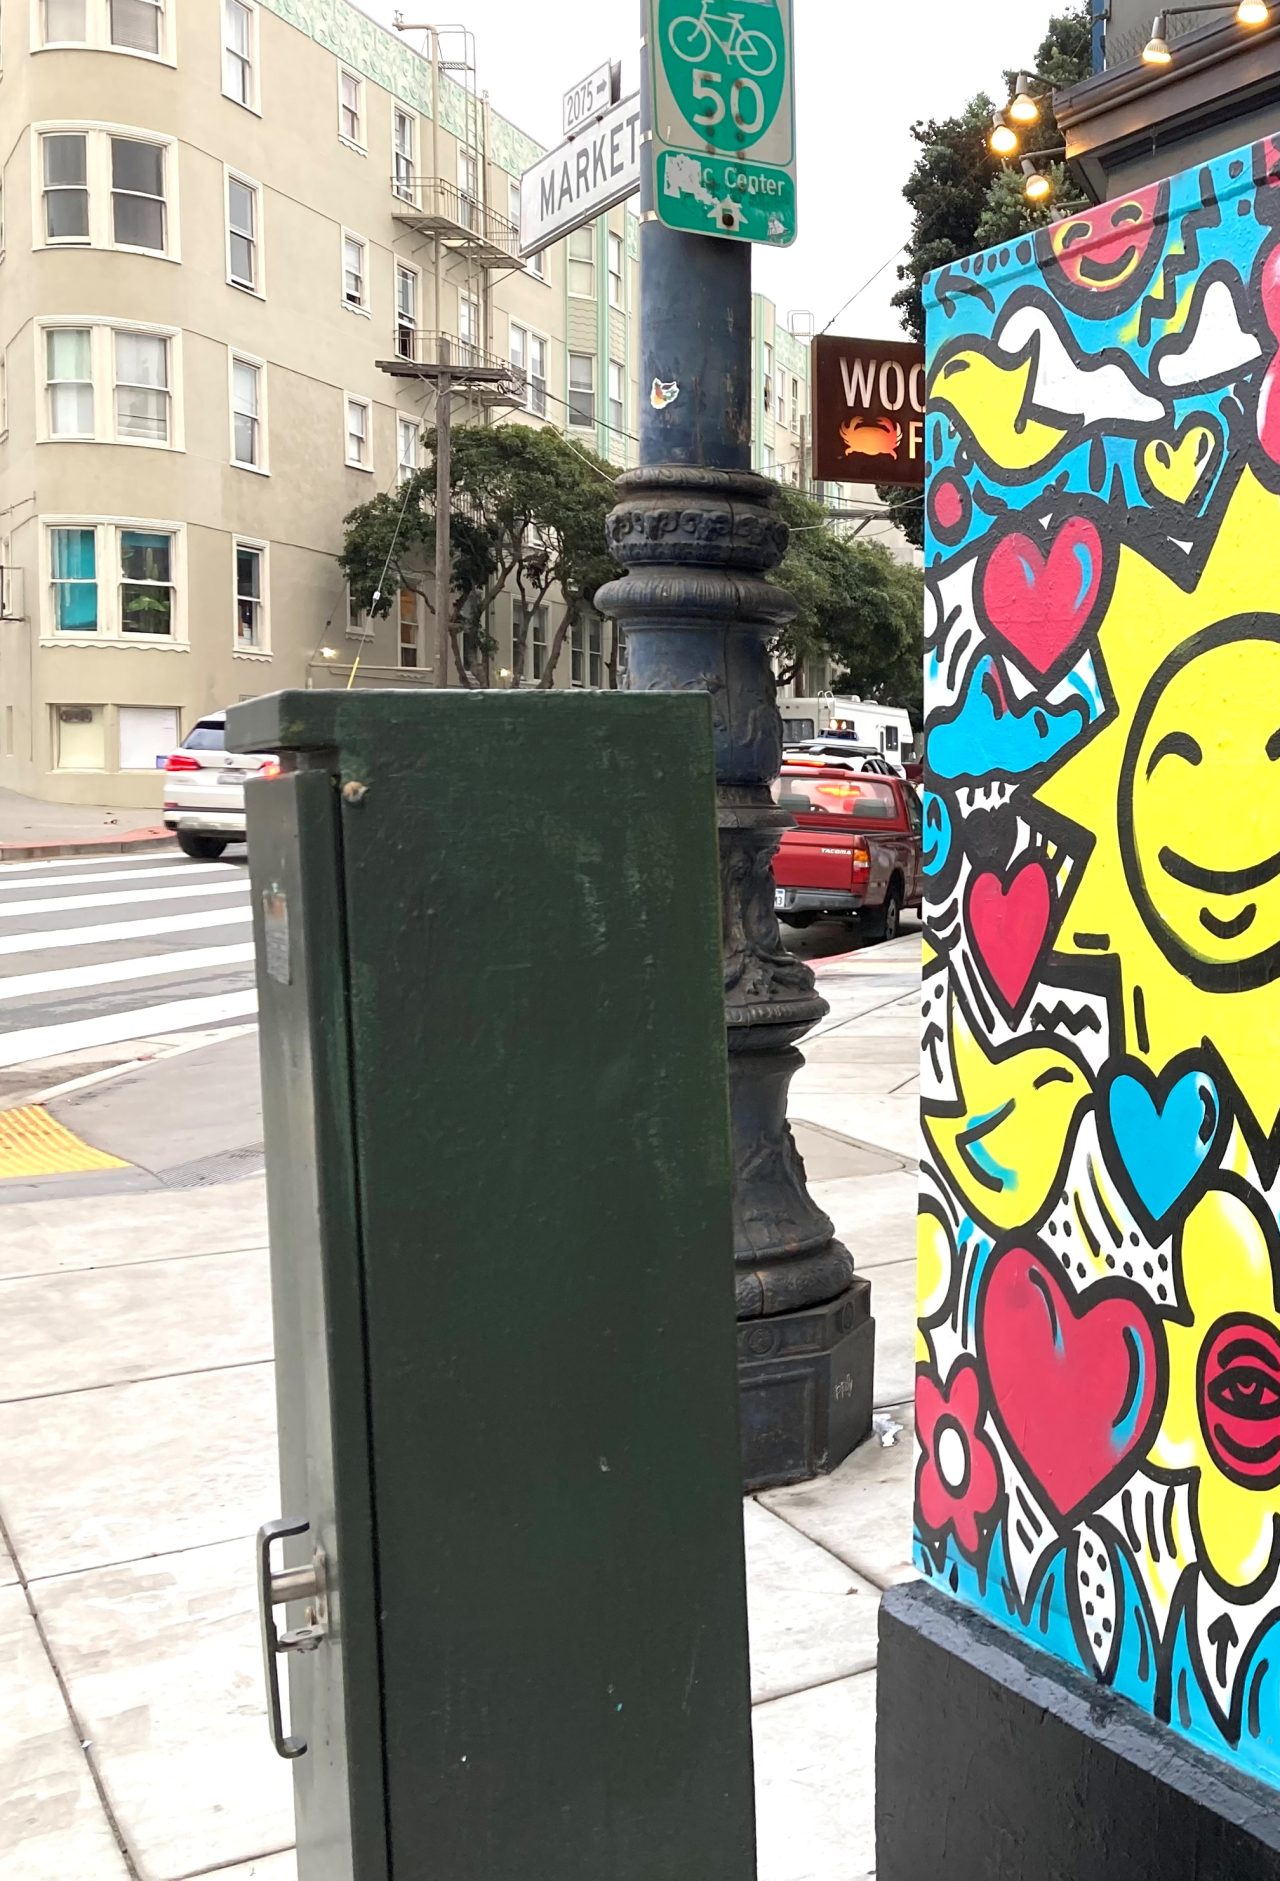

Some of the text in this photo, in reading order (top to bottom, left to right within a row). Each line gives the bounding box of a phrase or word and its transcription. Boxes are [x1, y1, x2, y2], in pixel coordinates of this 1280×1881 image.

[567, 80, 593, 126] 2075
[693, 68, 764, 133] 50
[541, 111, 640, 221] MARKET
[725, 167, 785, 196] Center
